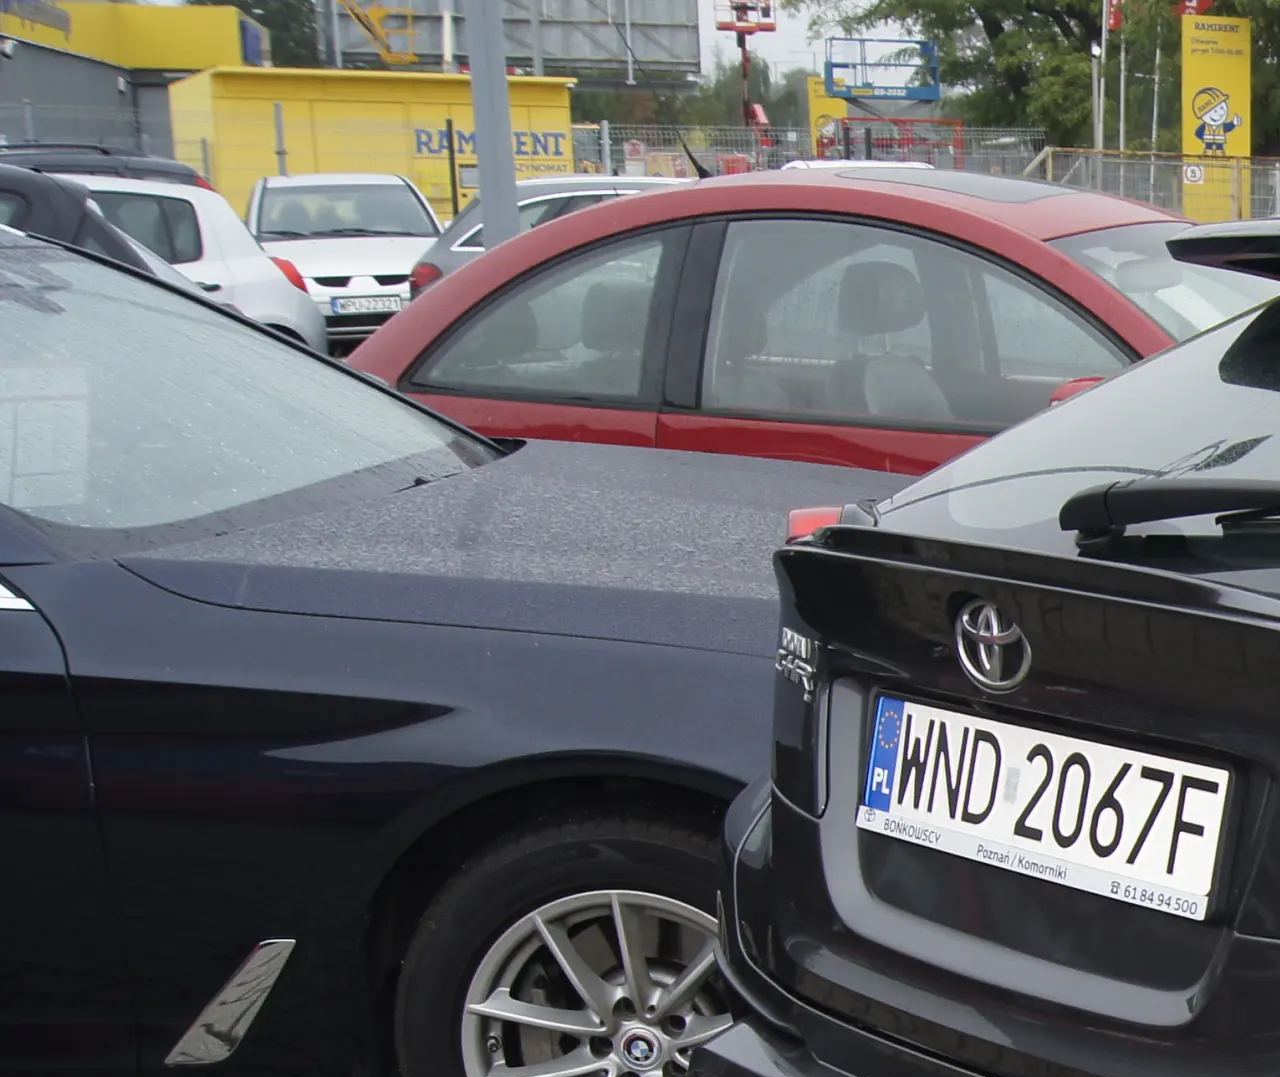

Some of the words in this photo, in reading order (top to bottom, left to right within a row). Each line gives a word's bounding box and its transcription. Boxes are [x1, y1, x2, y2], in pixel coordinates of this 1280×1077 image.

[414, 129, 566, 156] RAMENT
[871, 766, 891, 795] PL
[897, 713, 1002, 826] WND
[1013, 742, 1220, 876] 2067F
[883, 817, 942, 845] BOŃKOWSCY
[976, 844, 1010, 864] Poznań
[1017, 855, 1068, 880] Komorniki
[1123, 885, 1137, 900] 61
[1139, 888, 1155, 905] 84
[1155, 893, 1172, 909] 94
[1173, 897, 1199, 915] 500
